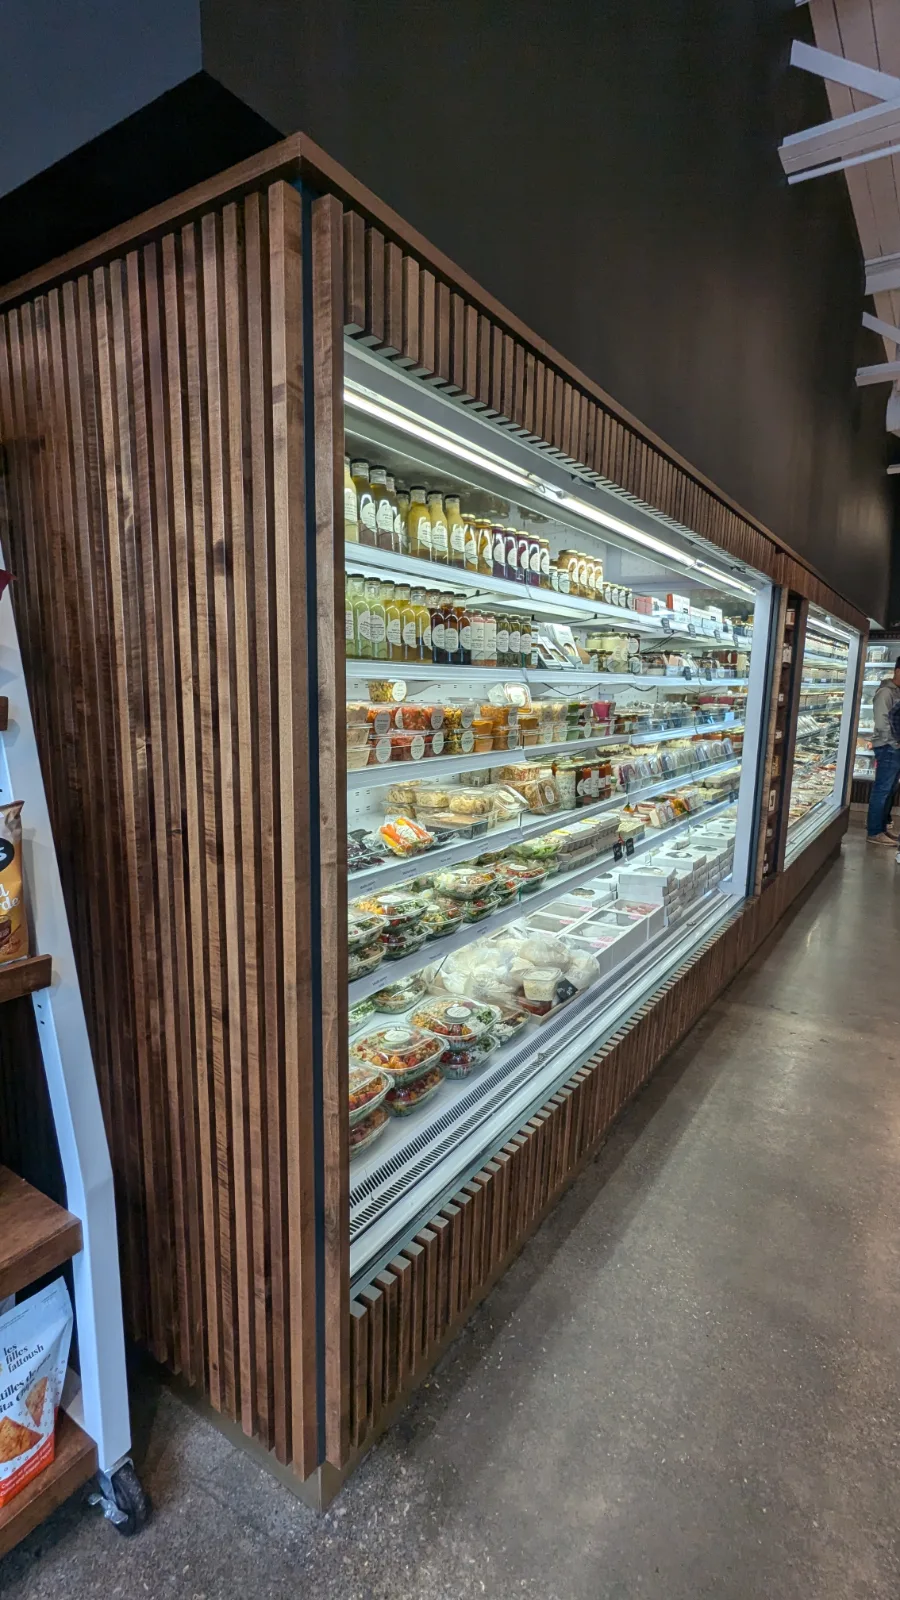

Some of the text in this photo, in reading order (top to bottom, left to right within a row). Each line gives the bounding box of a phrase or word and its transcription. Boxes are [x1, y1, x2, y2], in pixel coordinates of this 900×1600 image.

[4, 1344, 17, 1356] les
[6, 1346, 28, 1364] filles
[8, 1344, 44, 1373] fattoush
